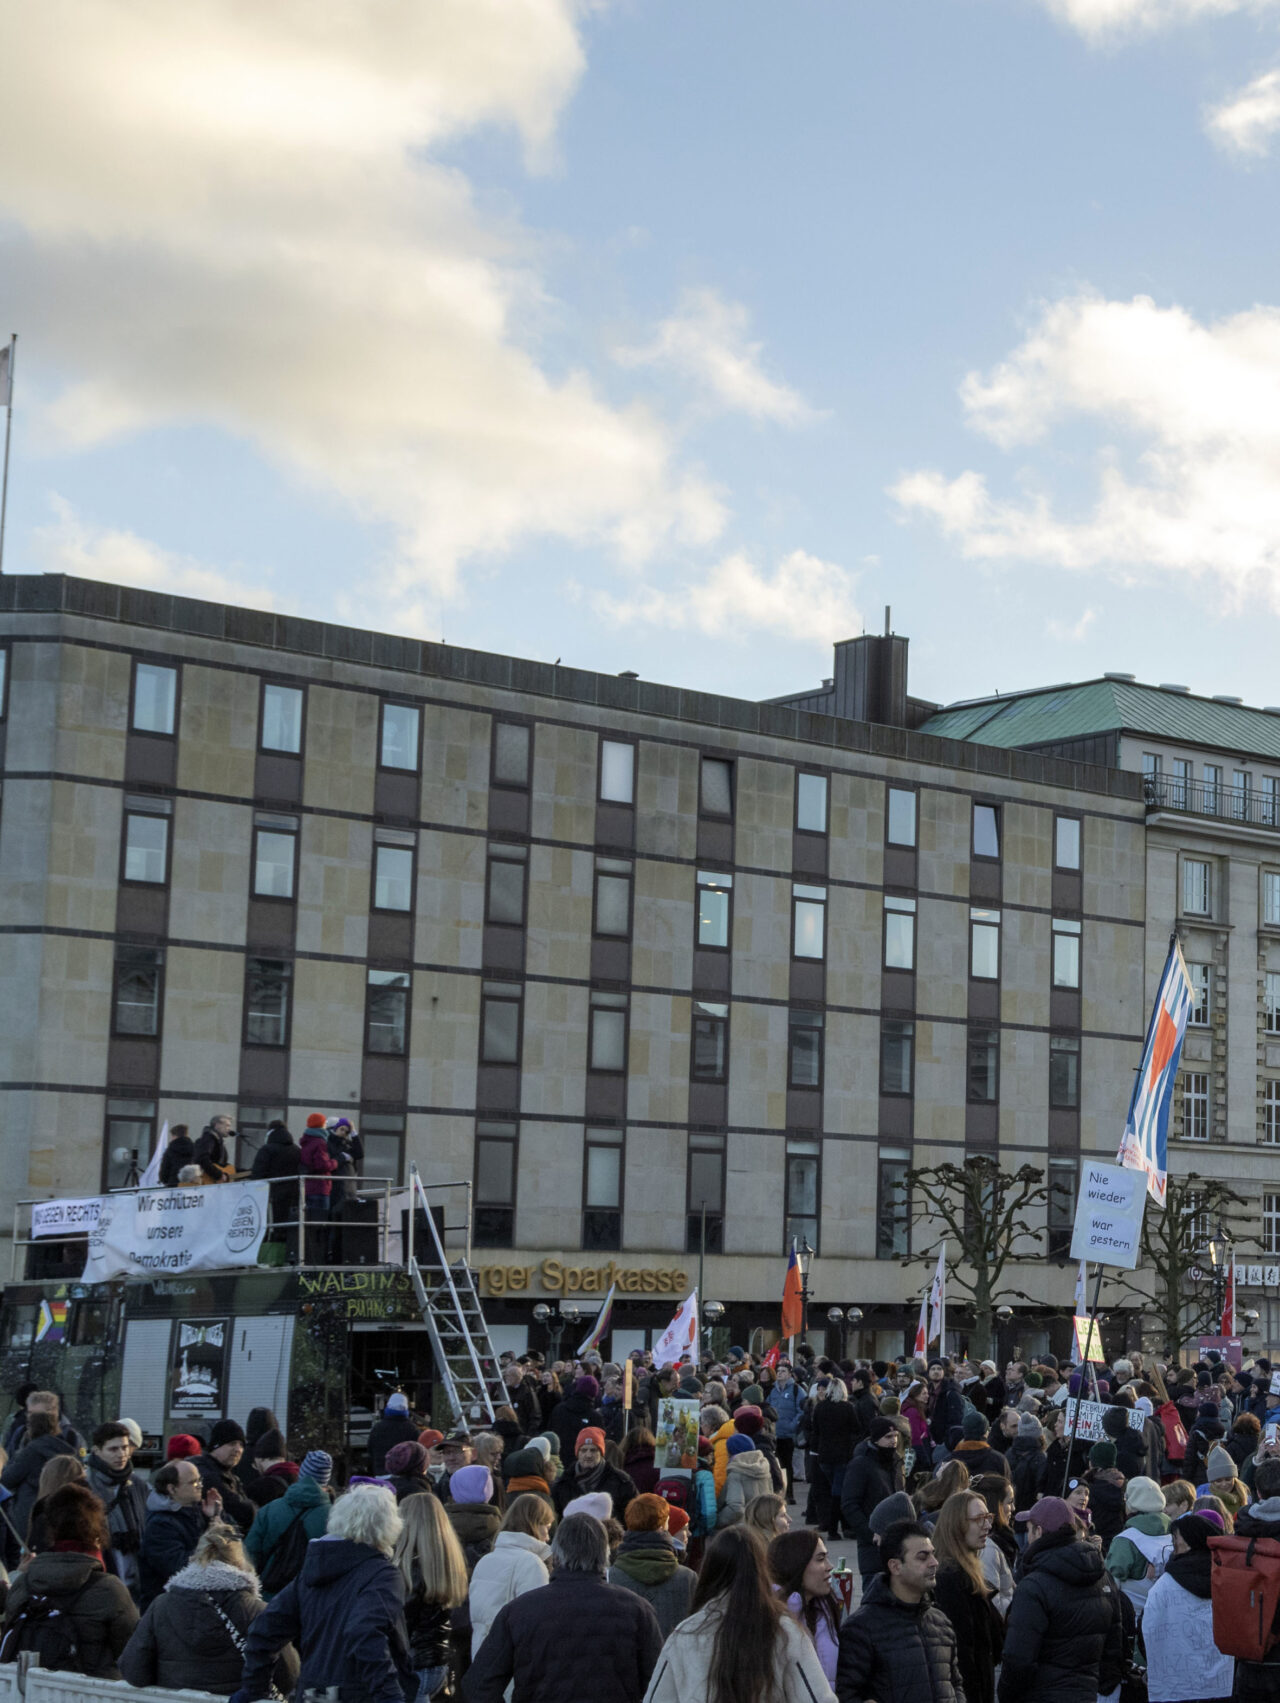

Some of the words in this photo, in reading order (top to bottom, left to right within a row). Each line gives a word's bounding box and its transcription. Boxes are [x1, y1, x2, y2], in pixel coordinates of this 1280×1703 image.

[1089, 1172, 1109, 1185] Nie
[137, 1195, 155, 1212] Wir
[157, 1193, 204, 1211] schützen
[1088, 1189, 1126, 1204] wieder
[66, 1203, 99, 1222] RECHTS
[1092, 1220, 1113, 1231] war
[147, 1226, 183, 1240] unsere
[1090, 1235, 1130, 1249] gestern
[541, 1258, 688, 1298] Sparkasse
[1069, 1410, 1094, 1419] DMIT
